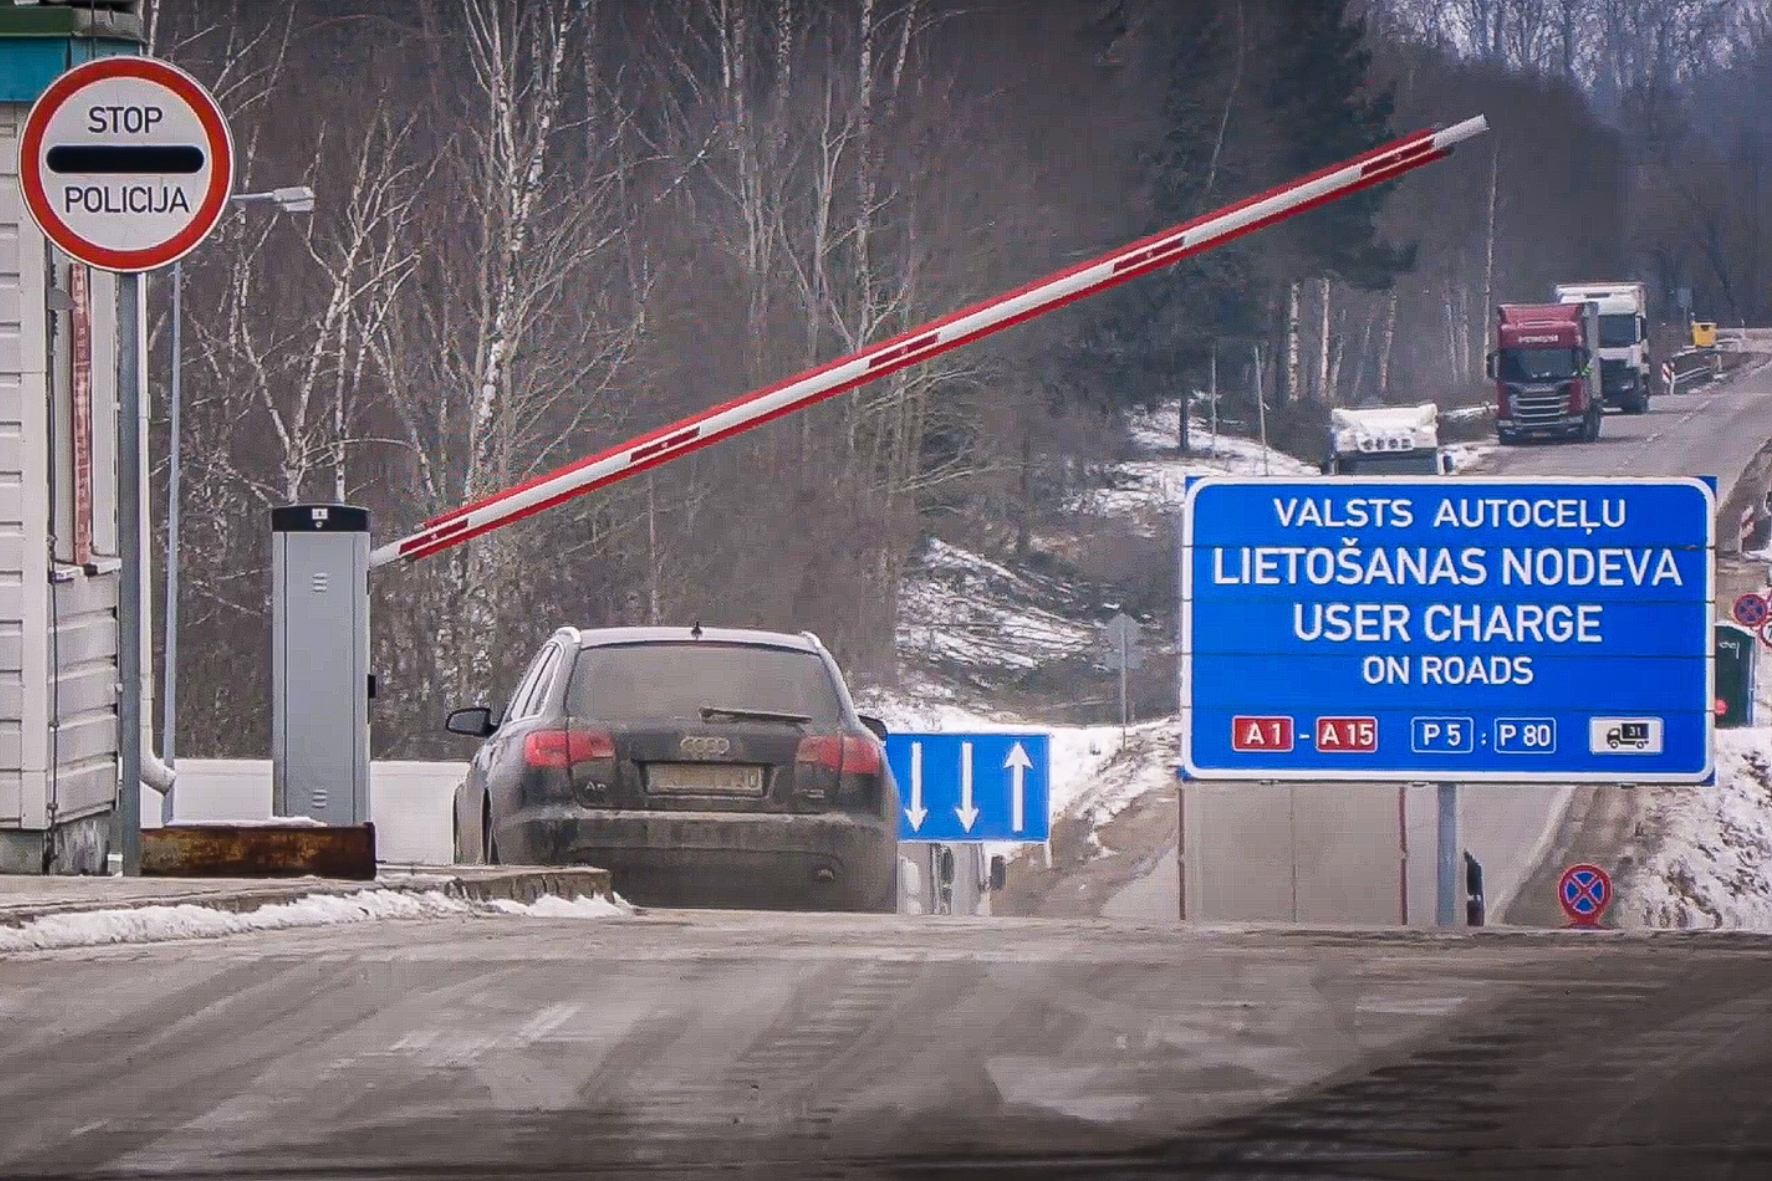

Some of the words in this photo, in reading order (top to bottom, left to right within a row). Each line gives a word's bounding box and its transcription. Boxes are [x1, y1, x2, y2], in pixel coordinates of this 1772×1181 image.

[88, 106, 163, 134] STOP
[64, 186, 190, 214] POLICIJA
[1273, 498, 1413, 528] VALSTS
[1433, 498, 1626, 535] AUTOCEĻU
[1213, 537, 1487, 586] LIETOŠANAS
[1502, 547, 1683, 586] NODEVA
[1294, 603, 1411, 642] USER
[1424, 604, 1603, 643] CHARGE
[1363, 656, 1410, 685] ON
[1421, 656, 1534, 685] ROADS
